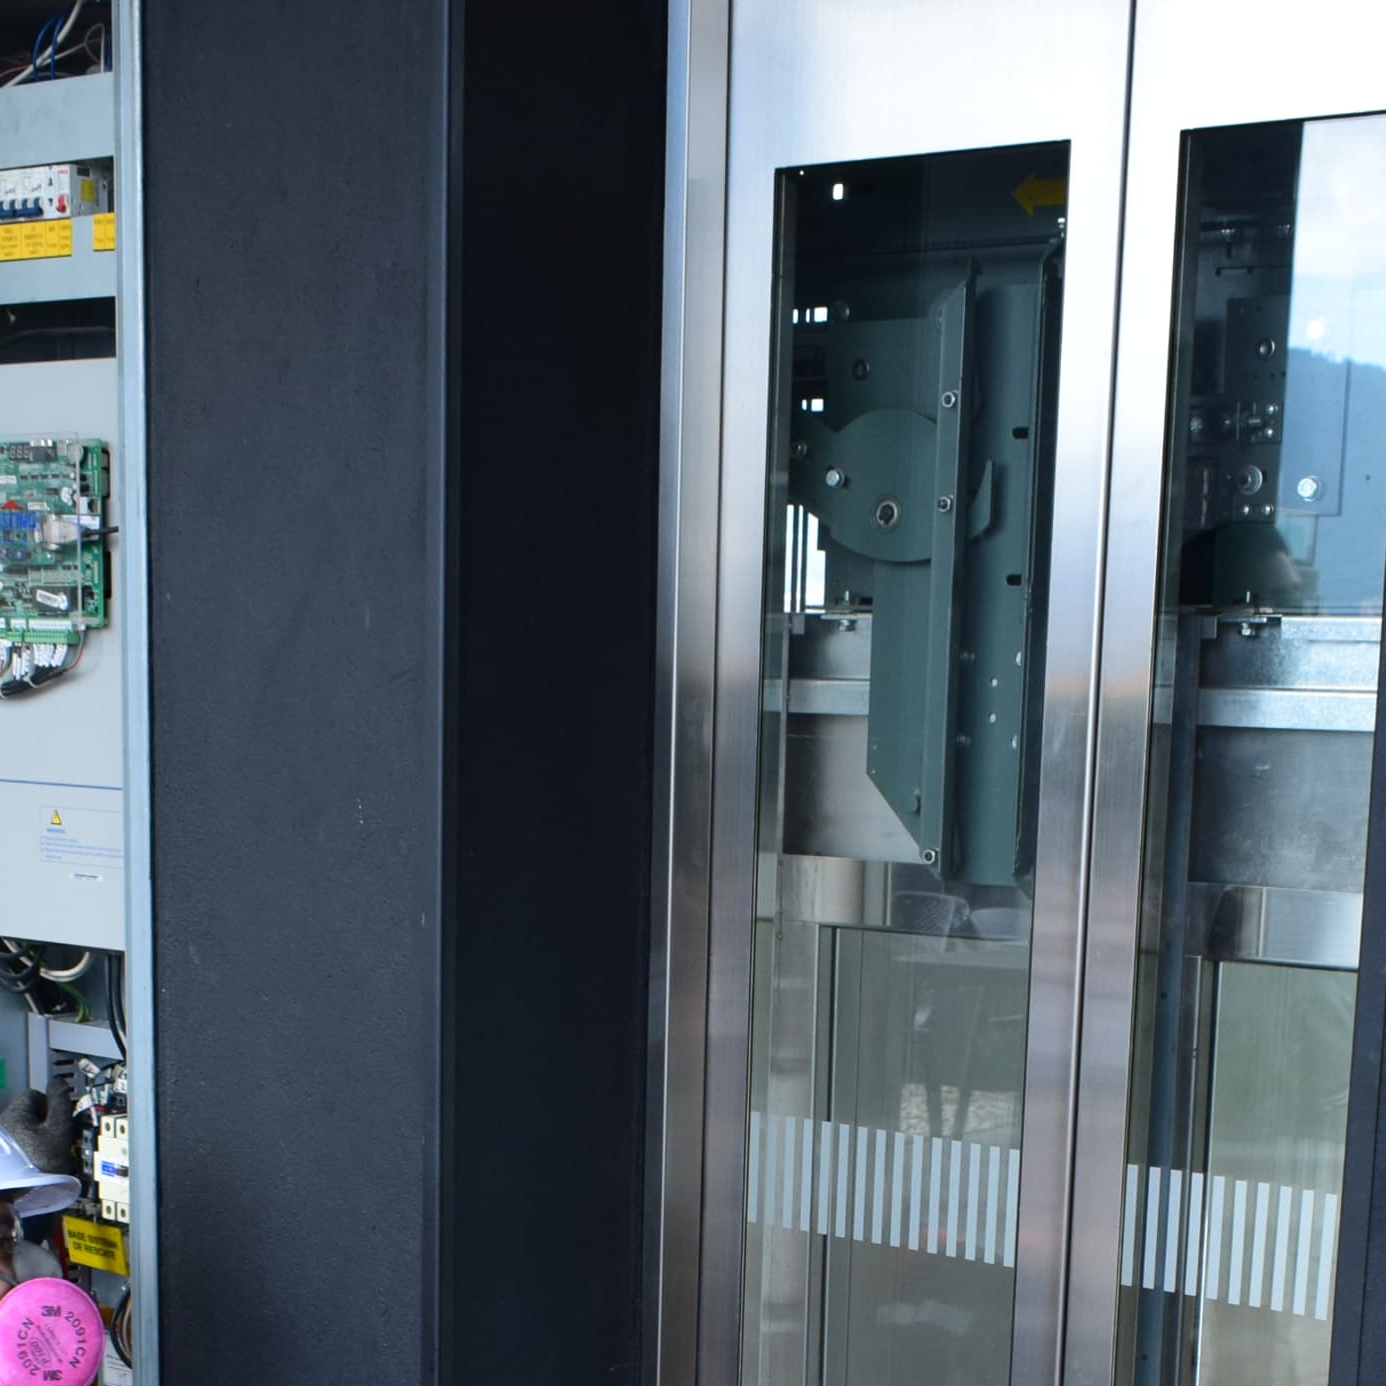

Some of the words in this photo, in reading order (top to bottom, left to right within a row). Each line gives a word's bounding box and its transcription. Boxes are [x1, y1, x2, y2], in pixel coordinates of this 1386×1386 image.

[41, 1305, 62, 1317] 3M
[16, 1317, 40, 1377] 2091CN
[64, 1311, 86, 1369] 2091CN
[42, 1369, 62, 1382] 3M
